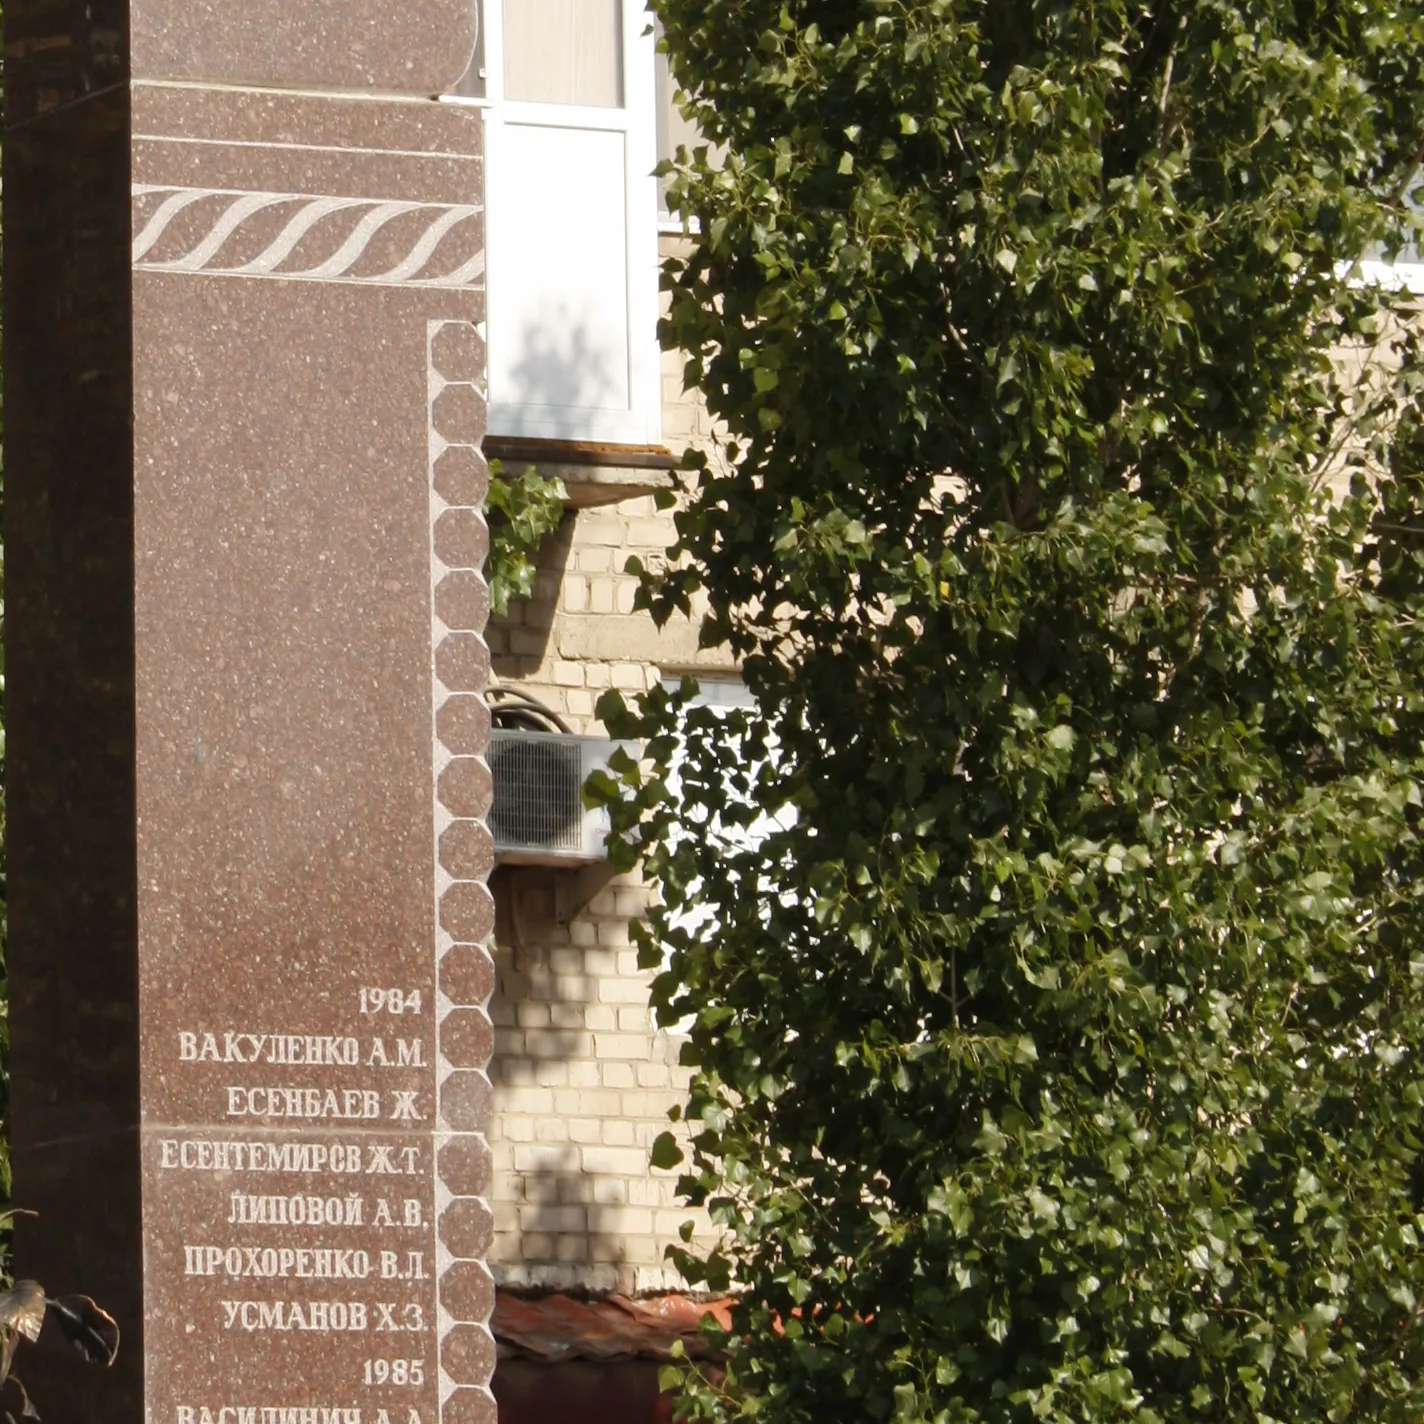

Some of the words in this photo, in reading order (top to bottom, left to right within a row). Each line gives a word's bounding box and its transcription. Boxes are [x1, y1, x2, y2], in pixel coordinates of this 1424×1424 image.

[358, 987, 422, 1015] 1984
[178, 1032, 359, 1066] ВАКУЛЕНКО
[226, 1087, 380, 1119] ЕСЕНБАЕВ
[389, 1091, 428, 1120] Ж.
[227, 1193, 364, 1226] ЛИПОВОЙ
[184, 1246, 371, 1278] ПРОХОРЕНКО
[221, 1301, 368, 1331] УСМАНОВ
[363, 1359, 425, 1386] 1985
